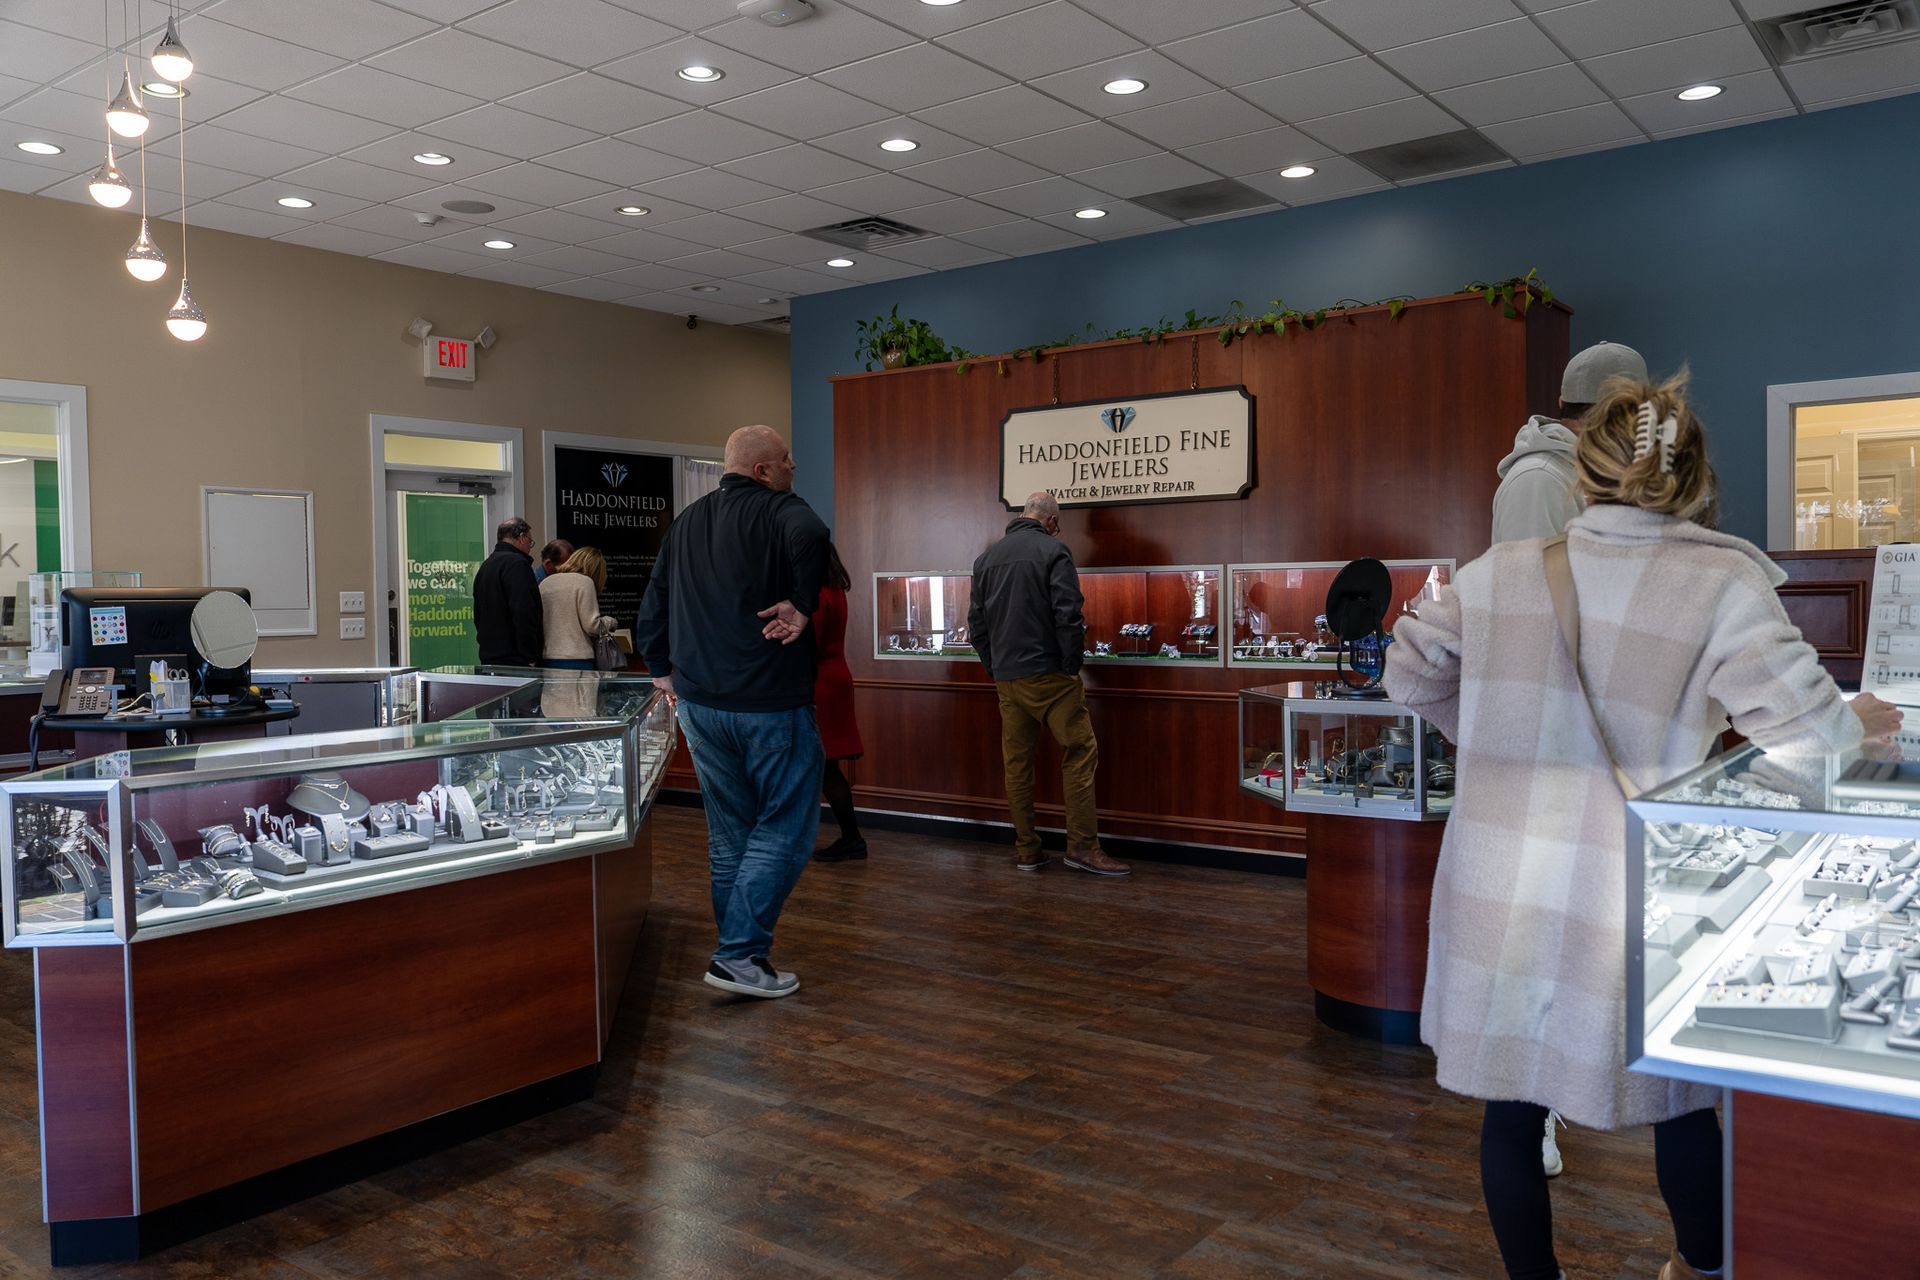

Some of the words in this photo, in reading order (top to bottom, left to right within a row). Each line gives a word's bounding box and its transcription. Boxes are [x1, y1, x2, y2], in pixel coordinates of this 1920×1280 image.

[438, 340, 468, 369] EXIT
[1018, 434, 1171, 464] HADDONFIELD
[1179, 429, 1231, 452] FINE
[1070, 457, 1169, 485] JEWELERS
[1089, 486, 1099, 497] &
[1100, 483, 1150, 498] JEWELRY
[1152, 480, 1196, 494] REPAIR
[561, 489, 666, 511] HADDONFIELD
[572, 511, 600, 526] FINE
[604, 512, 658, 529] JEWELERS
[408, 559, 468, 576] Together
[408, 579, 427, 590] we
[430, 578, 457, 590] can
[409, 594, 446, 605] move
